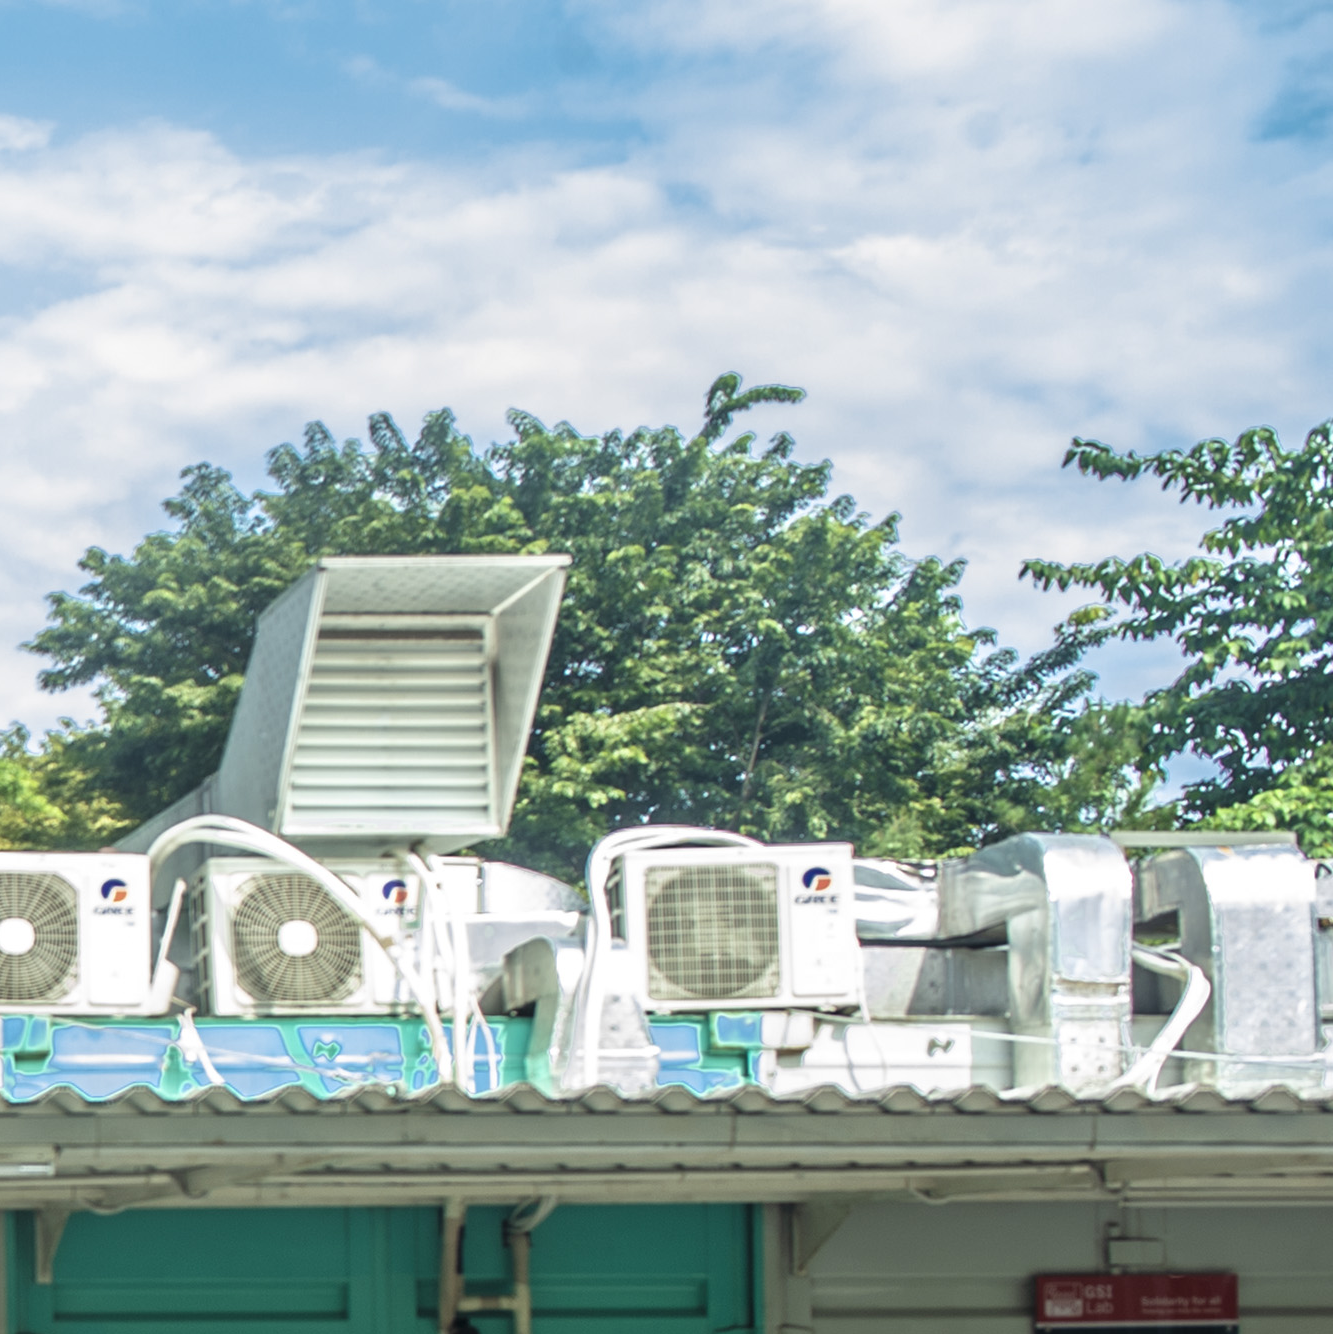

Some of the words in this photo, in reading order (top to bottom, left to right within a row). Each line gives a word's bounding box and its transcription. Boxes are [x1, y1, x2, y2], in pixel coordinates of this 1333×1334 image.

[1084, 1284, 1114, 1299] GSI
[1085, 1300, 1114, 1315] Lab
[1141, 1295, 1189, 1307] Solidarity
[1192, 1295, 1207, 1306] for
